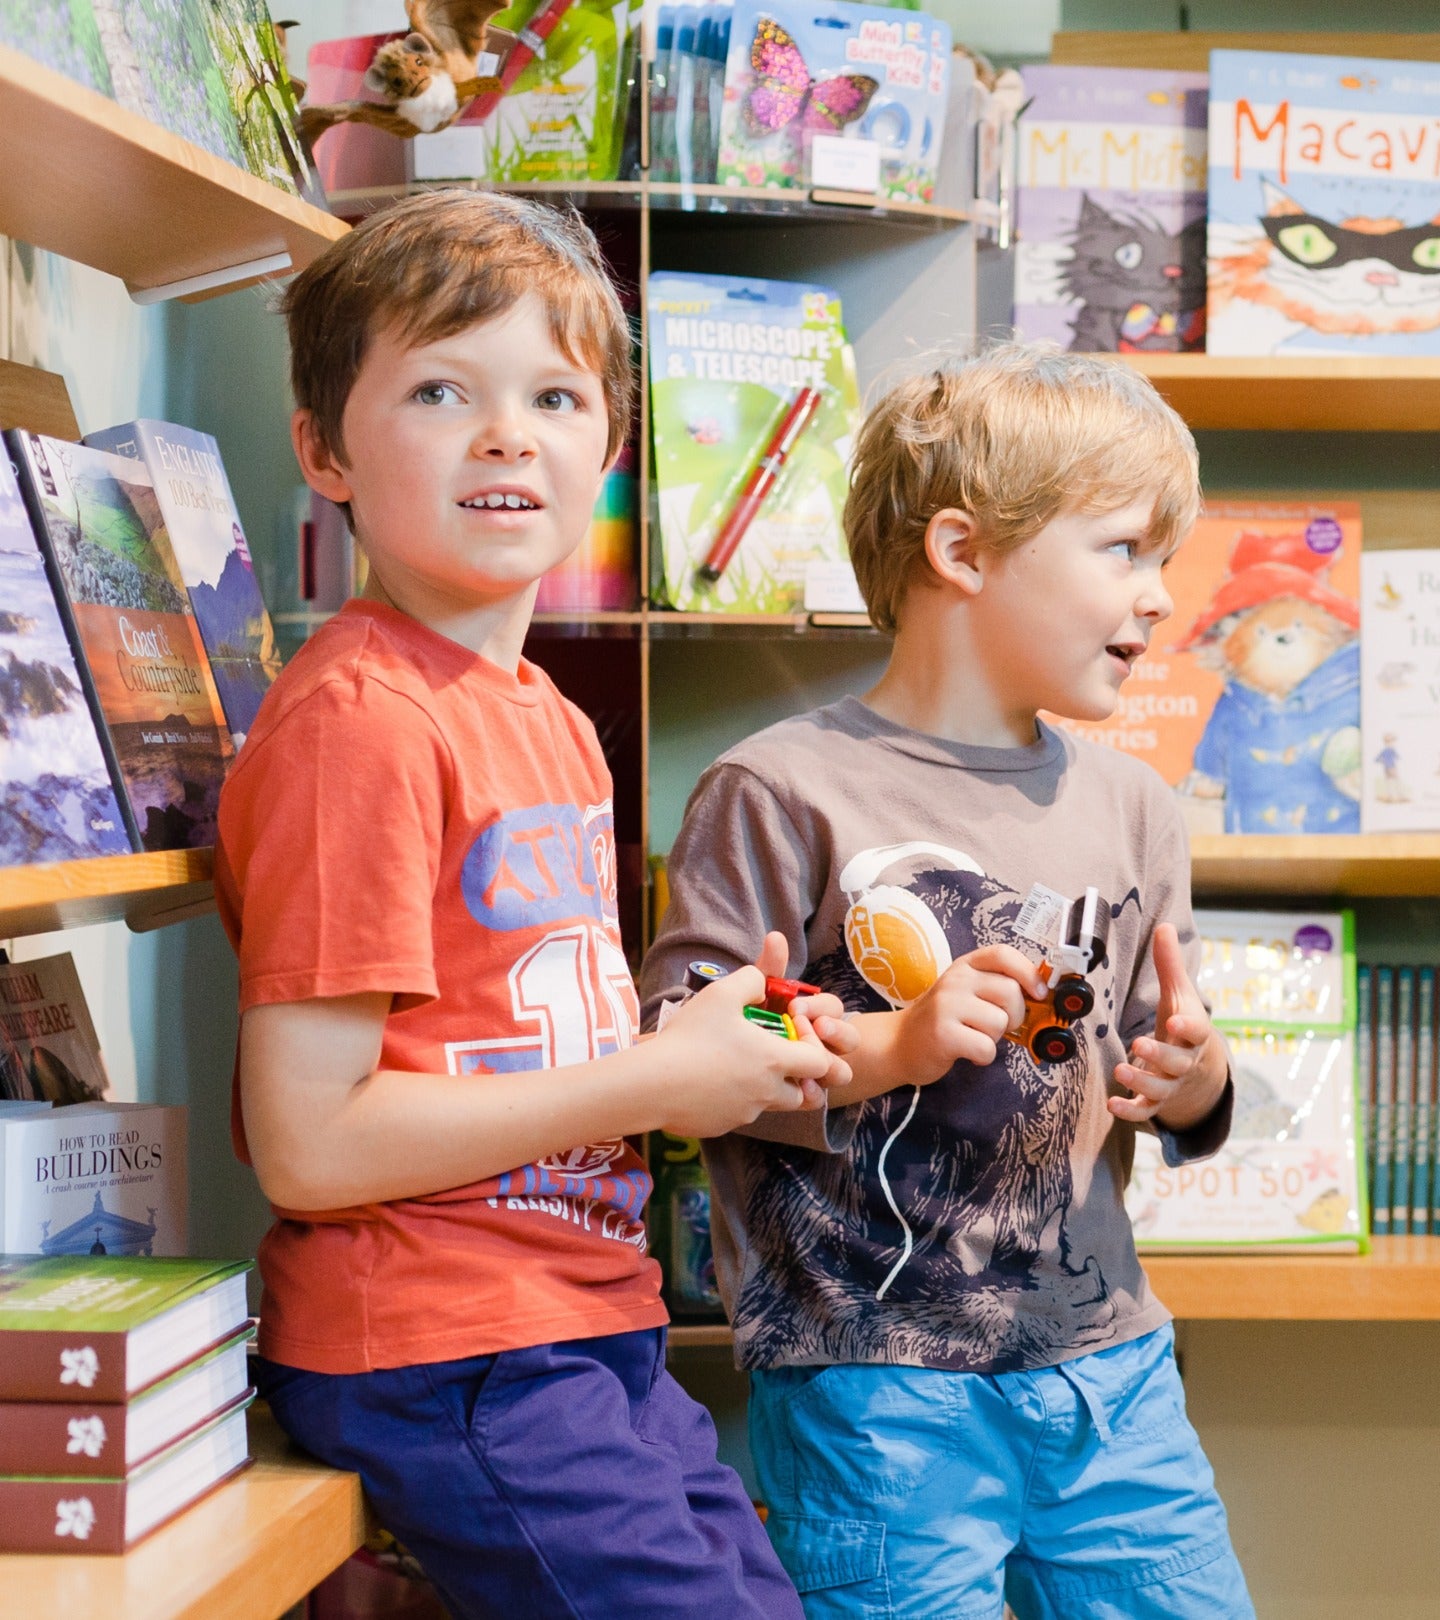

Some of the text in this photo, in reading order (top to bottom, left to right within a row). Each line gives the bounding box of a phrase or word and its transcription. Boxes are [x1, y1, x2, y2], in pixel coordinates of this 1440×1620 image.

[665, 317, 831, 361] MICROSCOPE
[668, 351, 826, 390] & TELESCOPE
[119, 615, 162, 658] Coast
[117, 650, 200, 706] Countryside
[1074, 722, 1158, 749] tories
[60, 1130, 139, 1152] HOW TO READ
[36, 1143, 162, 1183] BUILDINGS
[1154, 1166, 1304, 1198] SPOT 50
[602, 1210, 648, 1253] LEA
